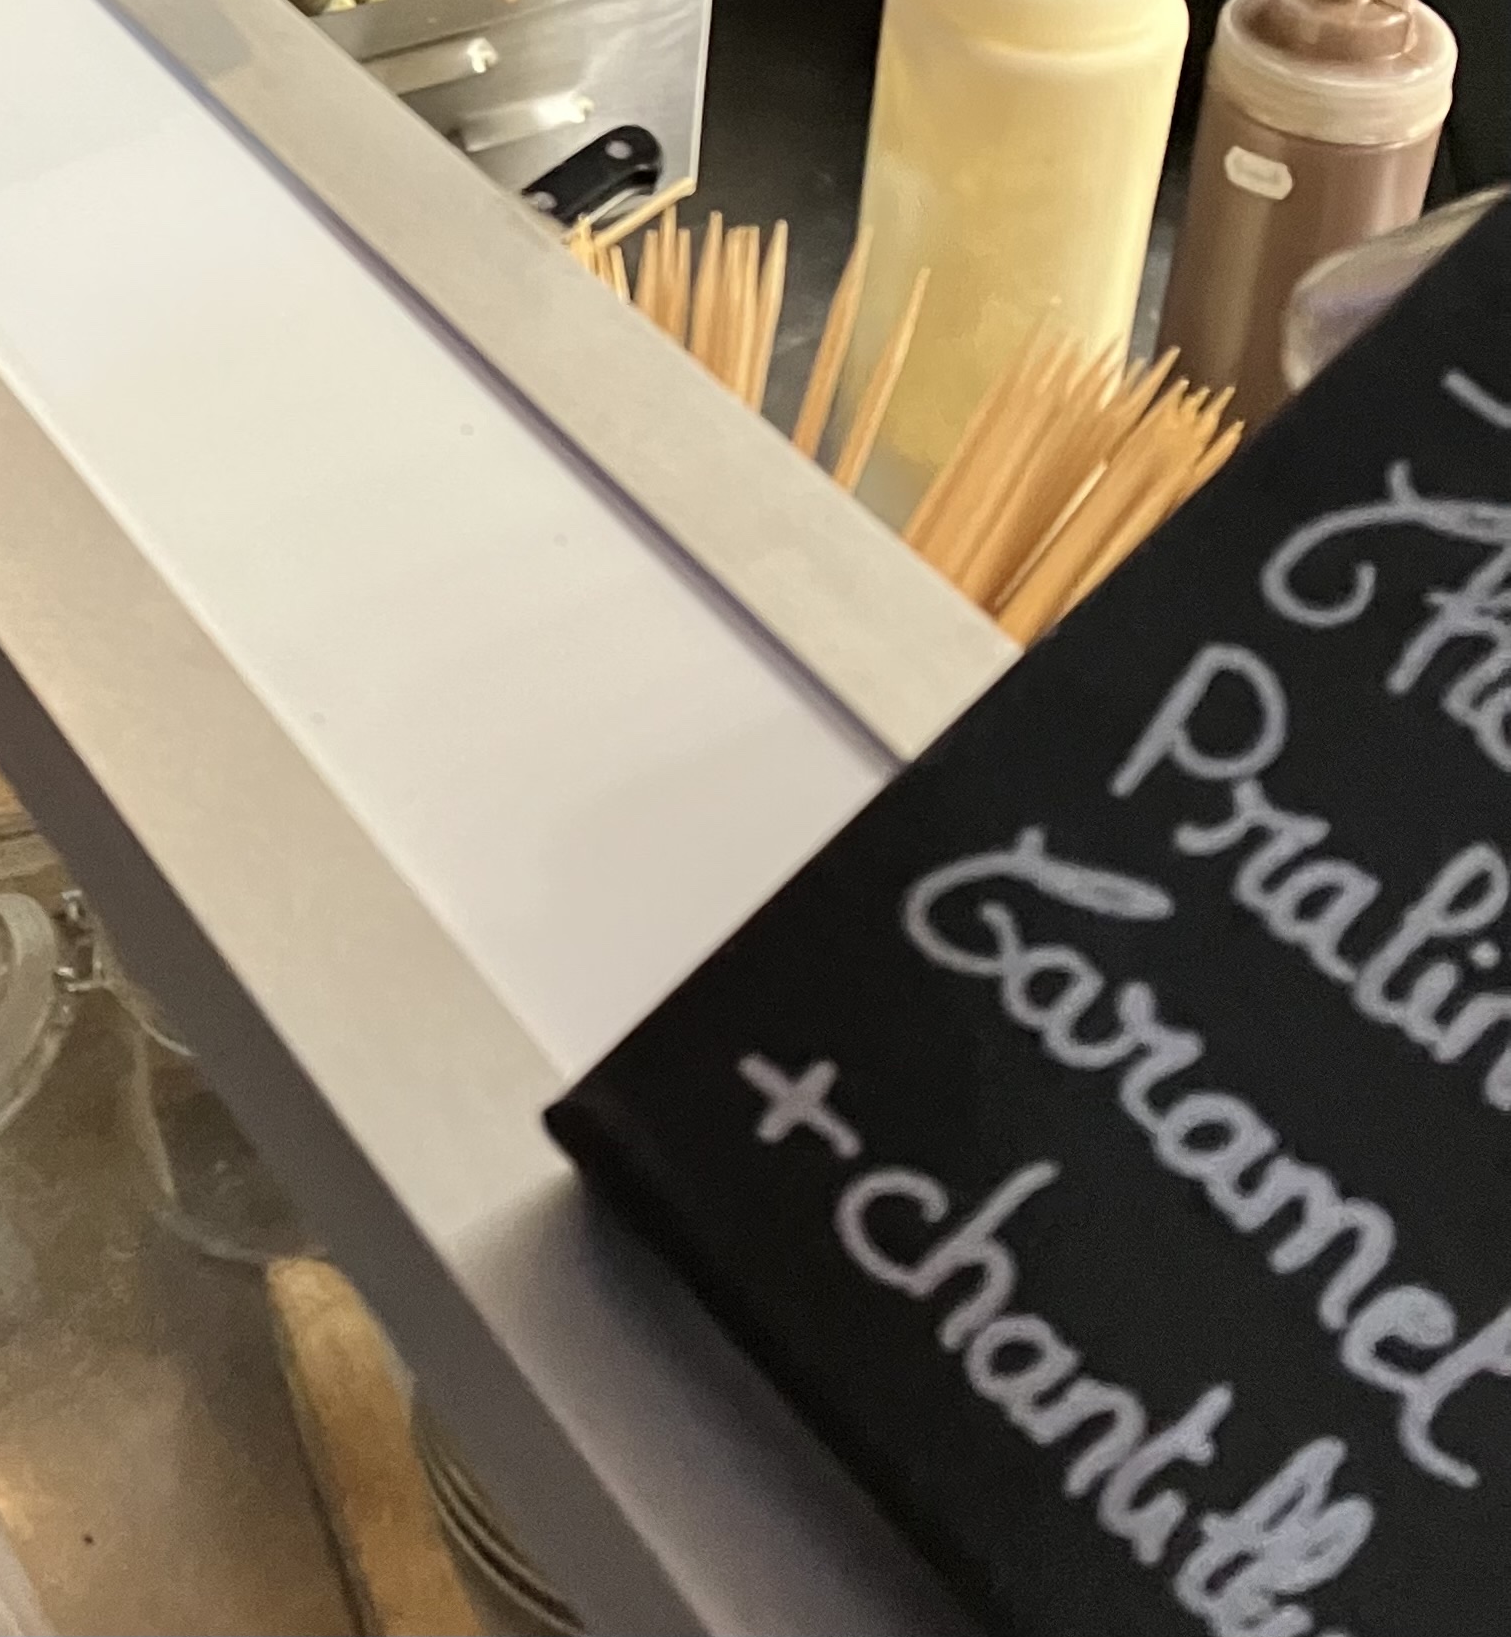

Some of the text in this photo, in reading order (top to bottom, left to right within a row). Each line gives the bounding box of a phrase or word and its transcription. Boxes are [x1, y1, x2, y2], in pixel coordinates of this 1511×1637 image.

[739, 1054, 1376, 1637] + chantill
[901, 822, 1511, 1489] Caramel
